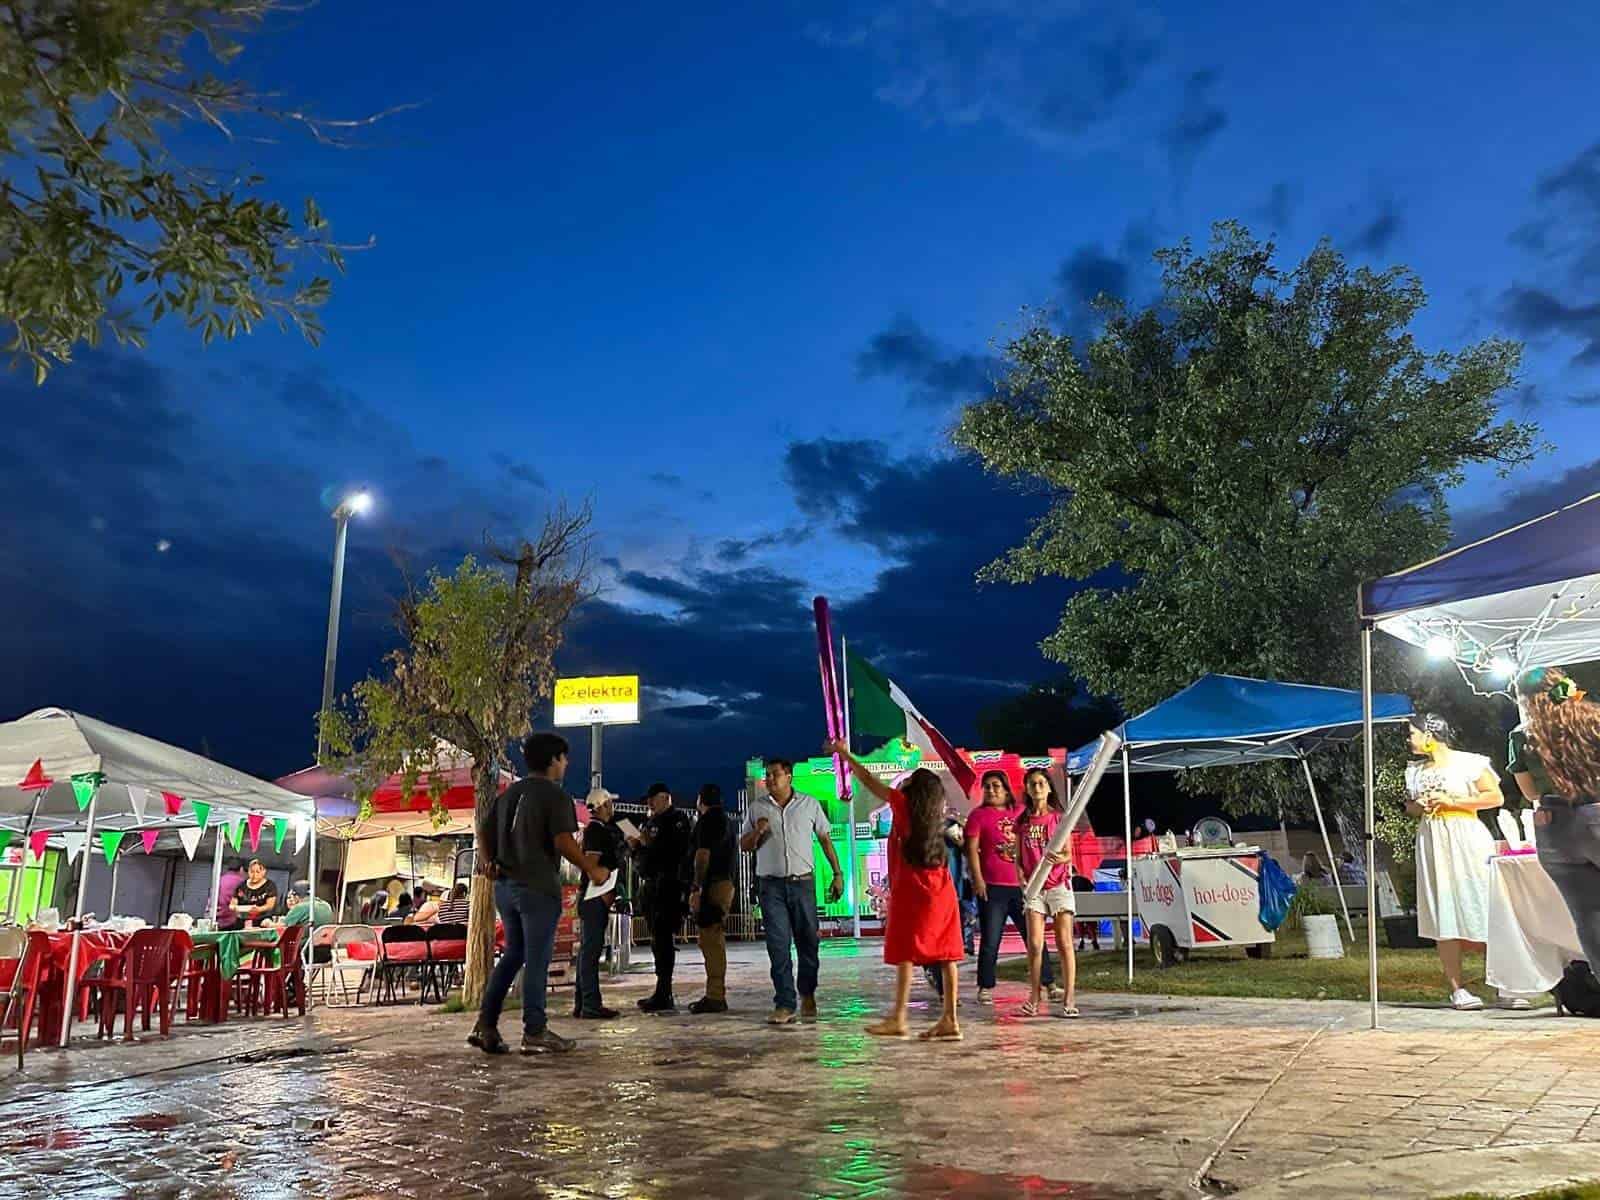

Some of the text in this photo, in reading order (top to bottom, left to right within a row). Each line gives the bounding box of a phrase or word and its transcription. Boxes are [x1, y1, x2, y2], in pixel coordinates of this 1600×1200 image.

[577, 684, 633, 698] elektra
[1141, 879, 1174, 906] hot-dogs
[1193, 882, 1255, 906] hot-dogs
